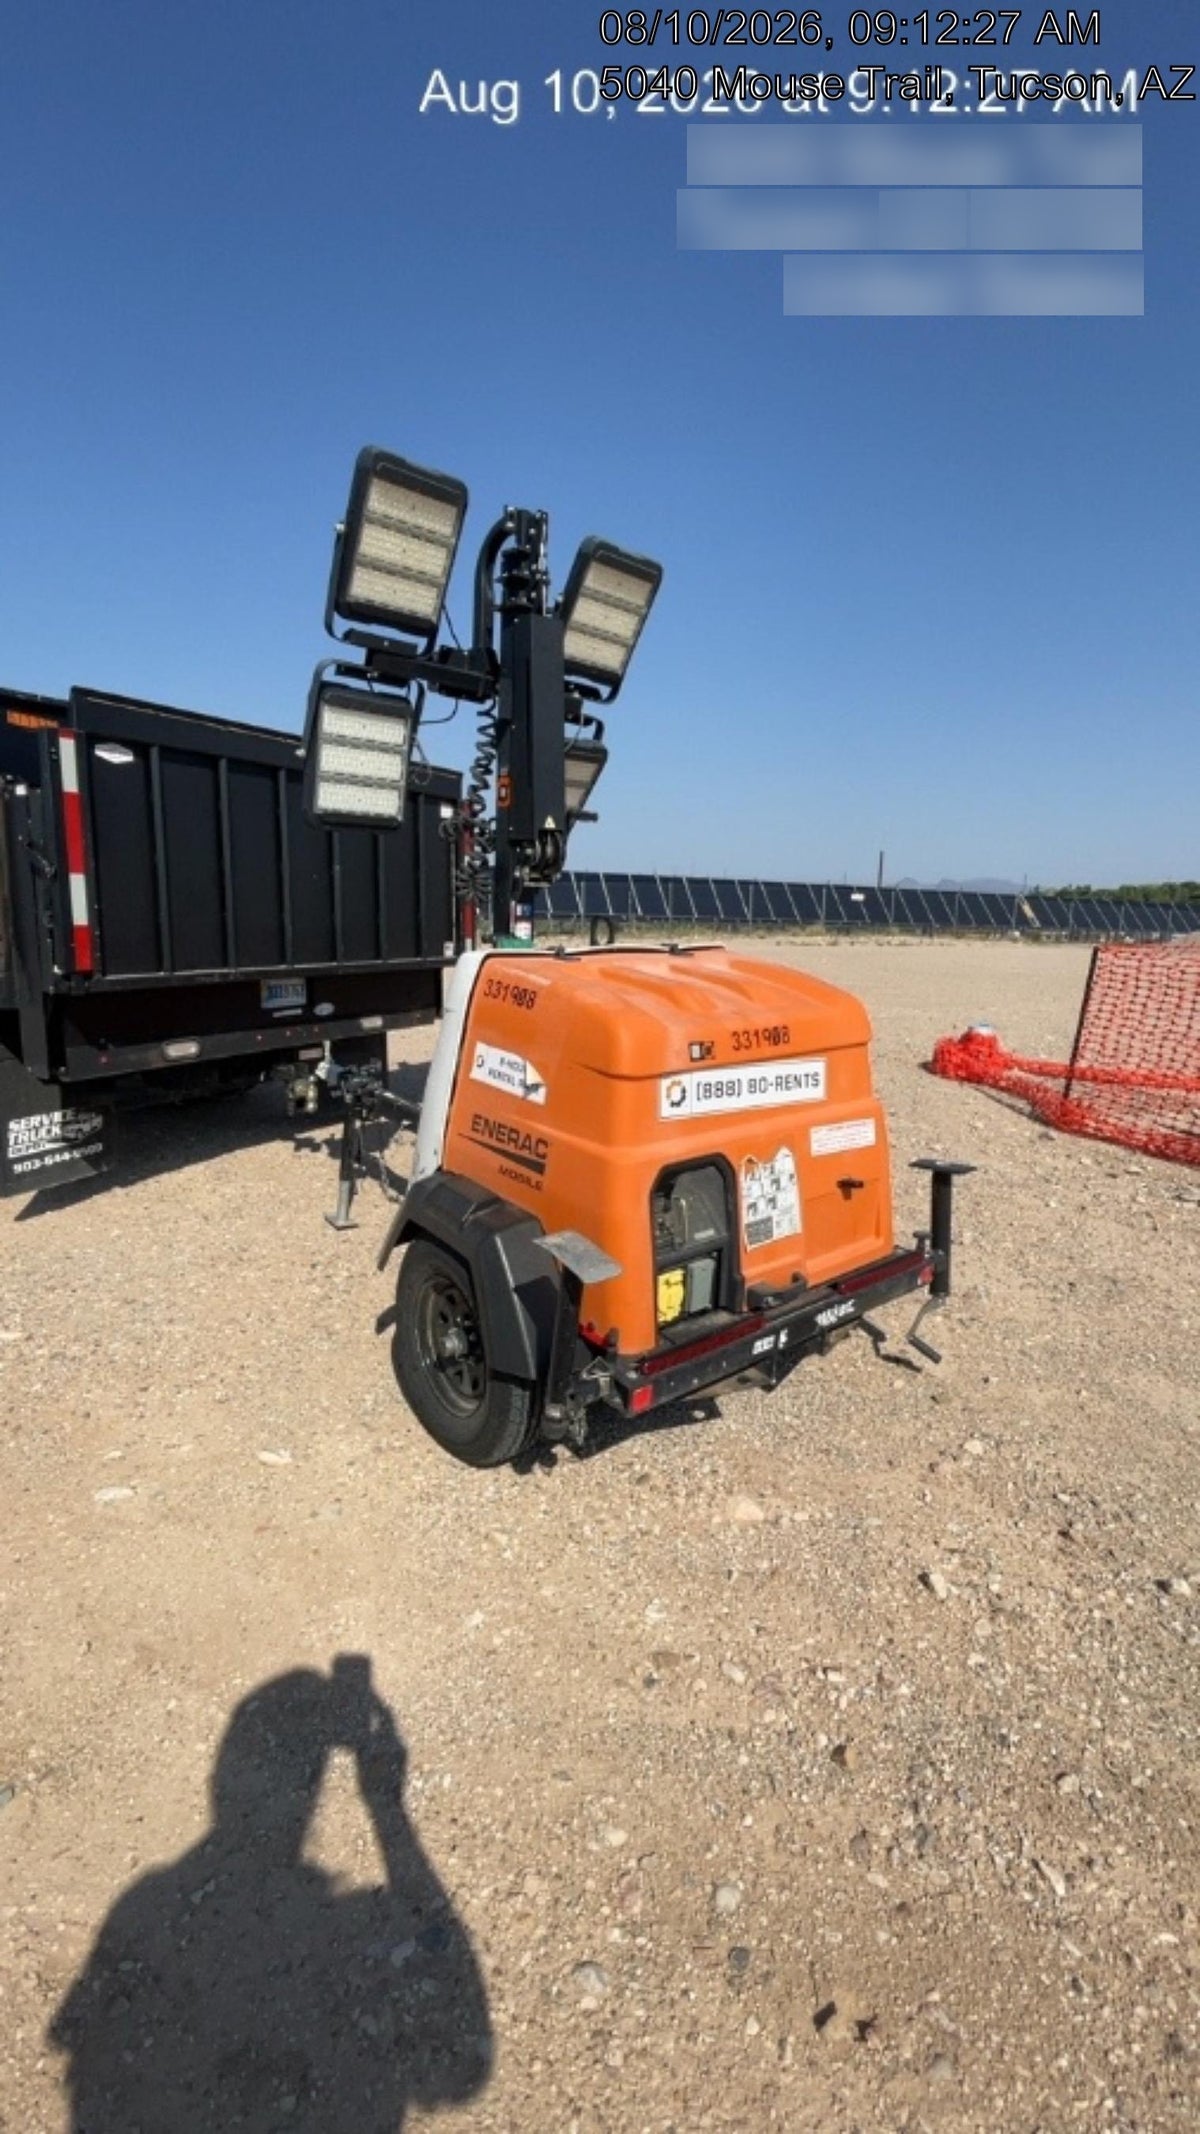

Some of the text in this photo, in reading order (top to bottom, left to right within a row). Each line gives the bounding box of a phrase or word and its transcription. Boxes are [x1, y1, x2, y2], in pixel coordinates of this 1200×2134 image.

[484, 979, 537, 1011] 331908
[731, 1026, 791, 1051] 331908
[9, 1125, 62, 1146] TRUCK
